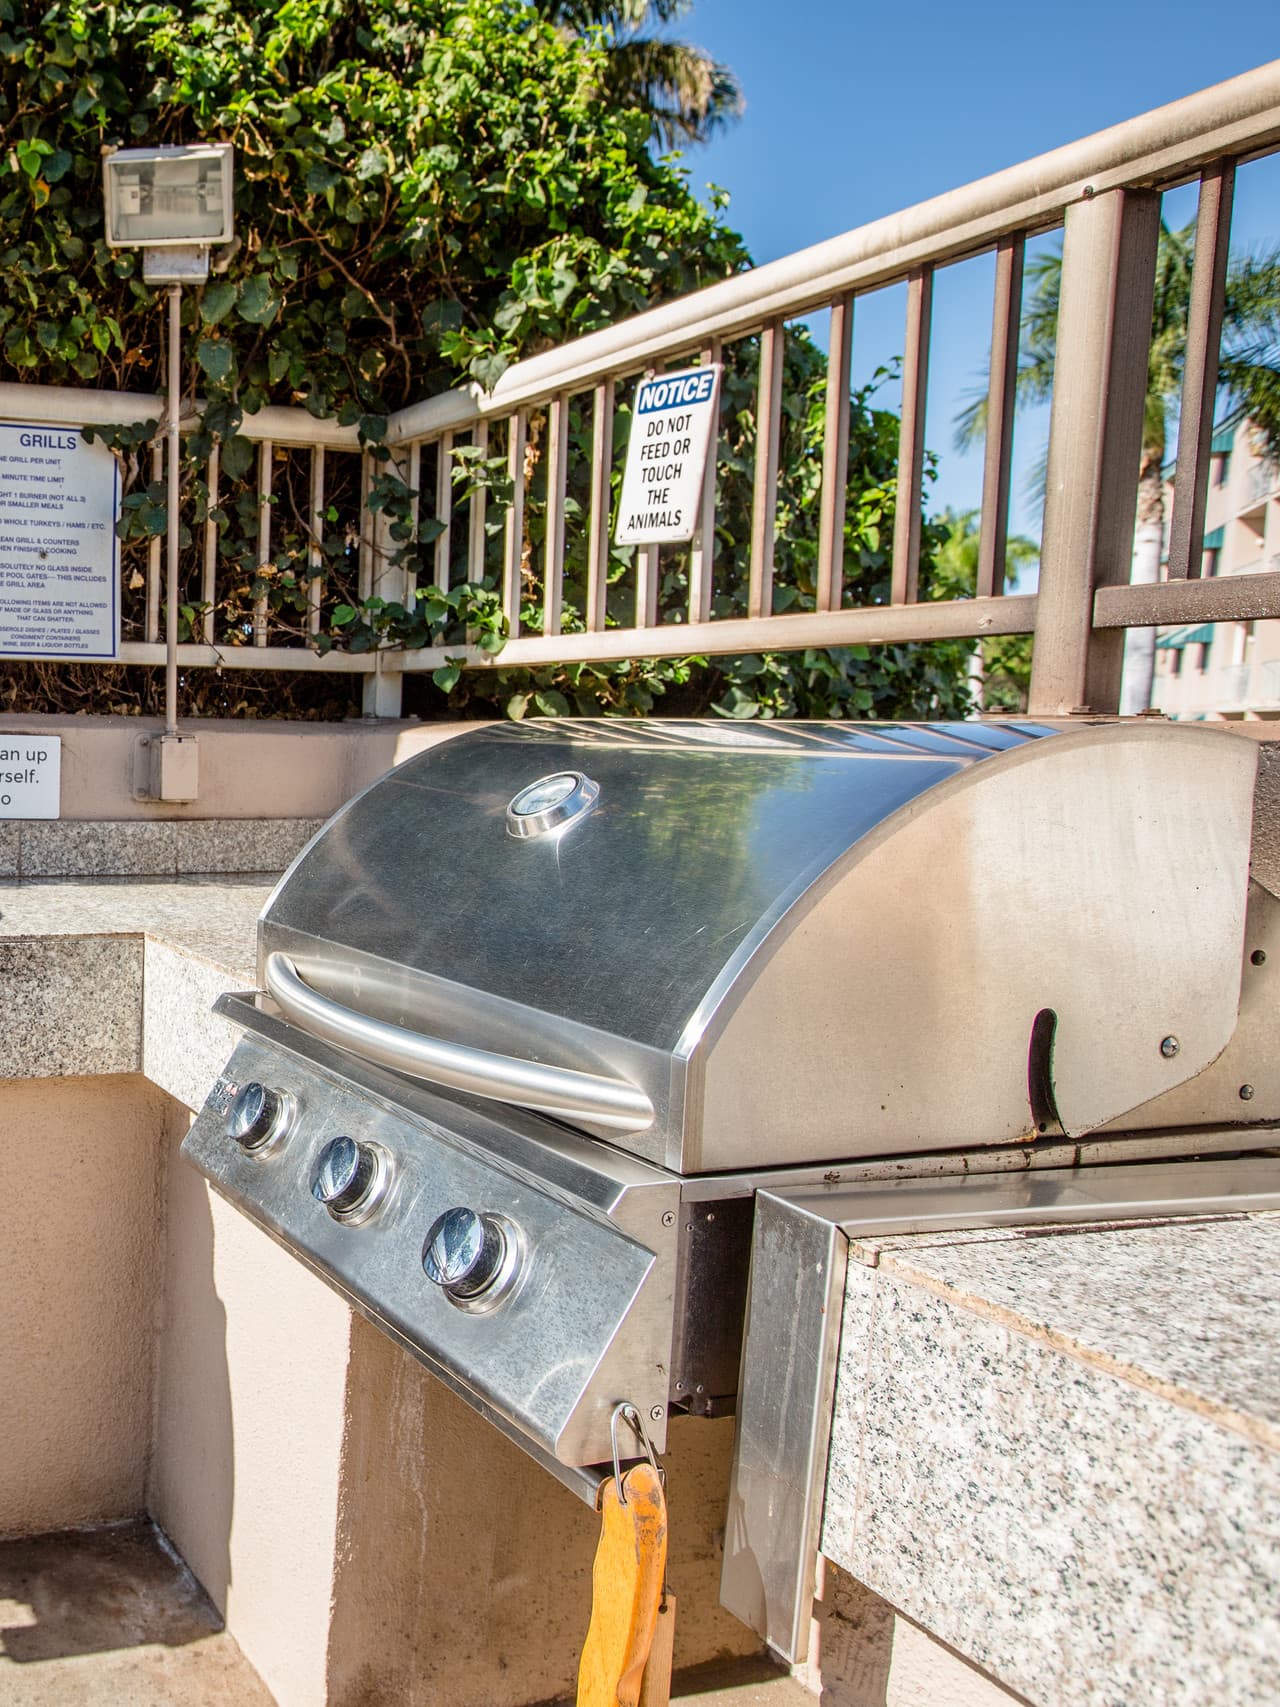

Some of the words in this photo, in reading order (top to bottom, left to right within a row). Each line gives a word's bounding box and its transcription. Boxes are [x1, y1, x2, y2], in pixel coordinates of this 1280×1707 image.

[640, 373, 713, 410] NOTICE
[647, 420, 664, 437] DO
[667, 414, 692, 433] NOT
[20, 434, 77, 449] GRILLS
[641, 442, 670, 461] FEED
[673, 438, 691, 455] OR
[642, 463, 682, 483] TOUCH
[49, 493, 64, 501] (NOT
[647, 488, 669, 505] THE
[4, 518, 27, 526] WHOLE
[30, 520, 60, 528] TURKEYS
[627, 510, 682, 530] ANIMALS
[43, 538, 79, 546] COUNTERS
[78, 601, 107, 609] ALLOWED
[26, 750, 47, 764] up
